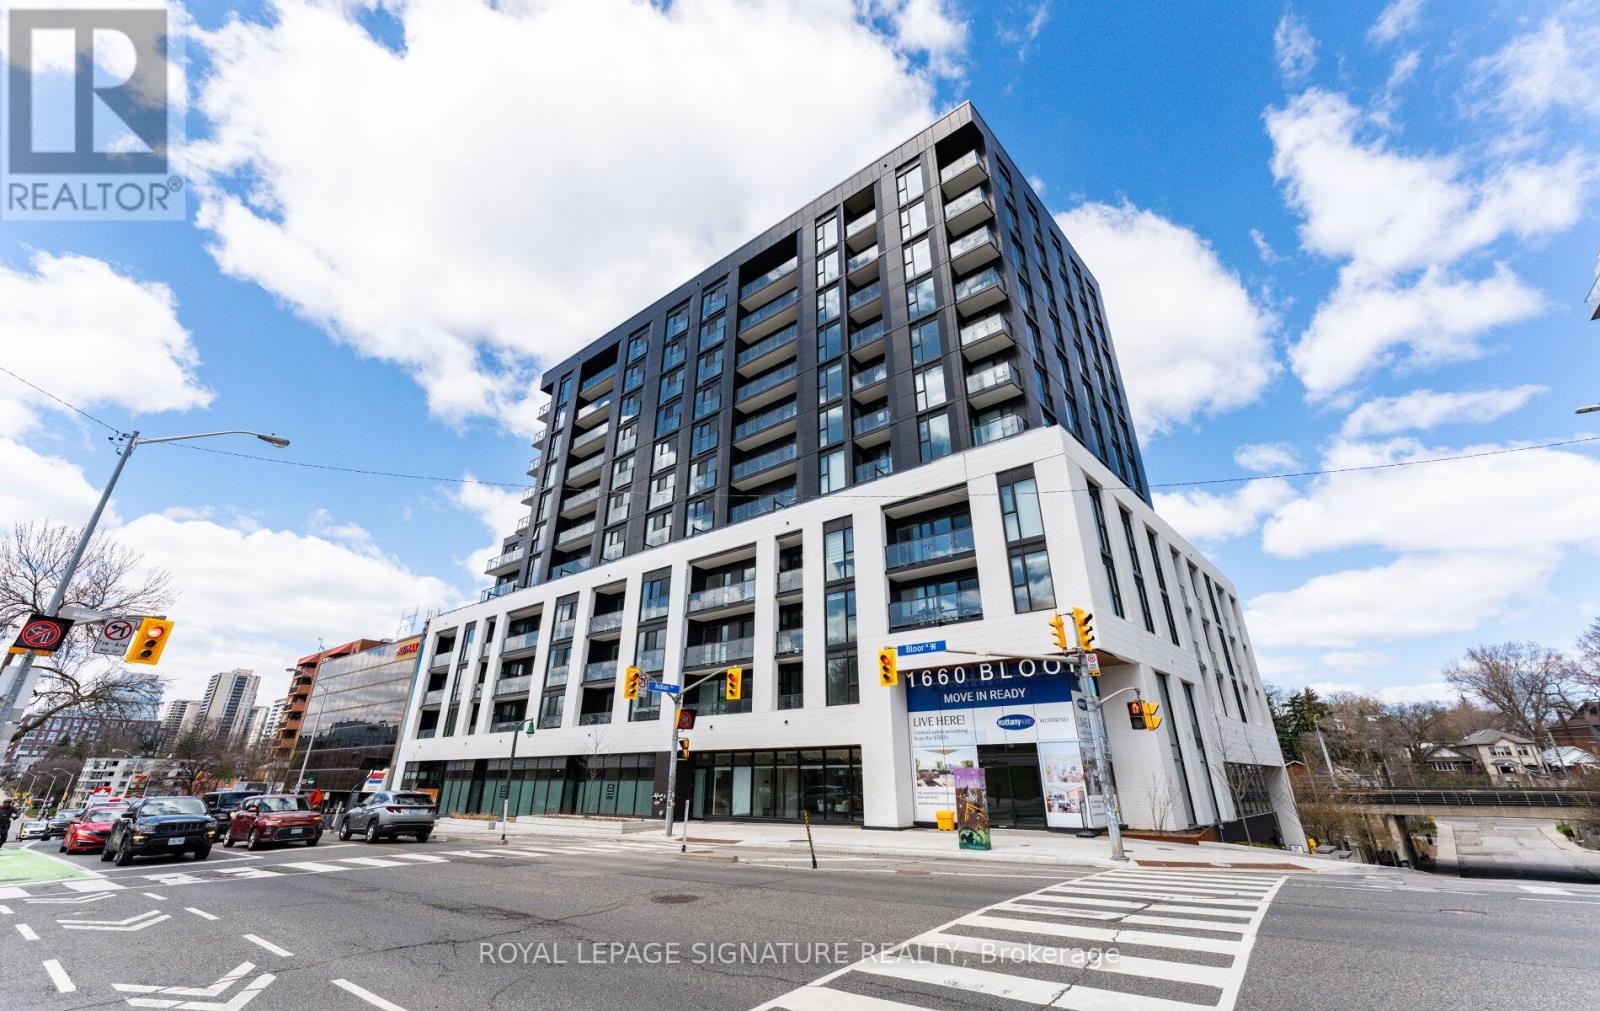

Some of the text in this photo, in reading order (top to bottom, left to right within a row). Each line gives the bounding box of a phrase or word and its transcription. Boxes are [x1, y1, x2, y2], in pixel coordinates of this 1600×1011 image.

[905, 645, 924, 654] Bloor
[930, 642, 937, 650] W
[907, 659, 1075, 688] 1660 BLOO
[944, 688, 1026, 703] MOVE IN READY
[913, 714, 965, 727] LIVE HERE!
